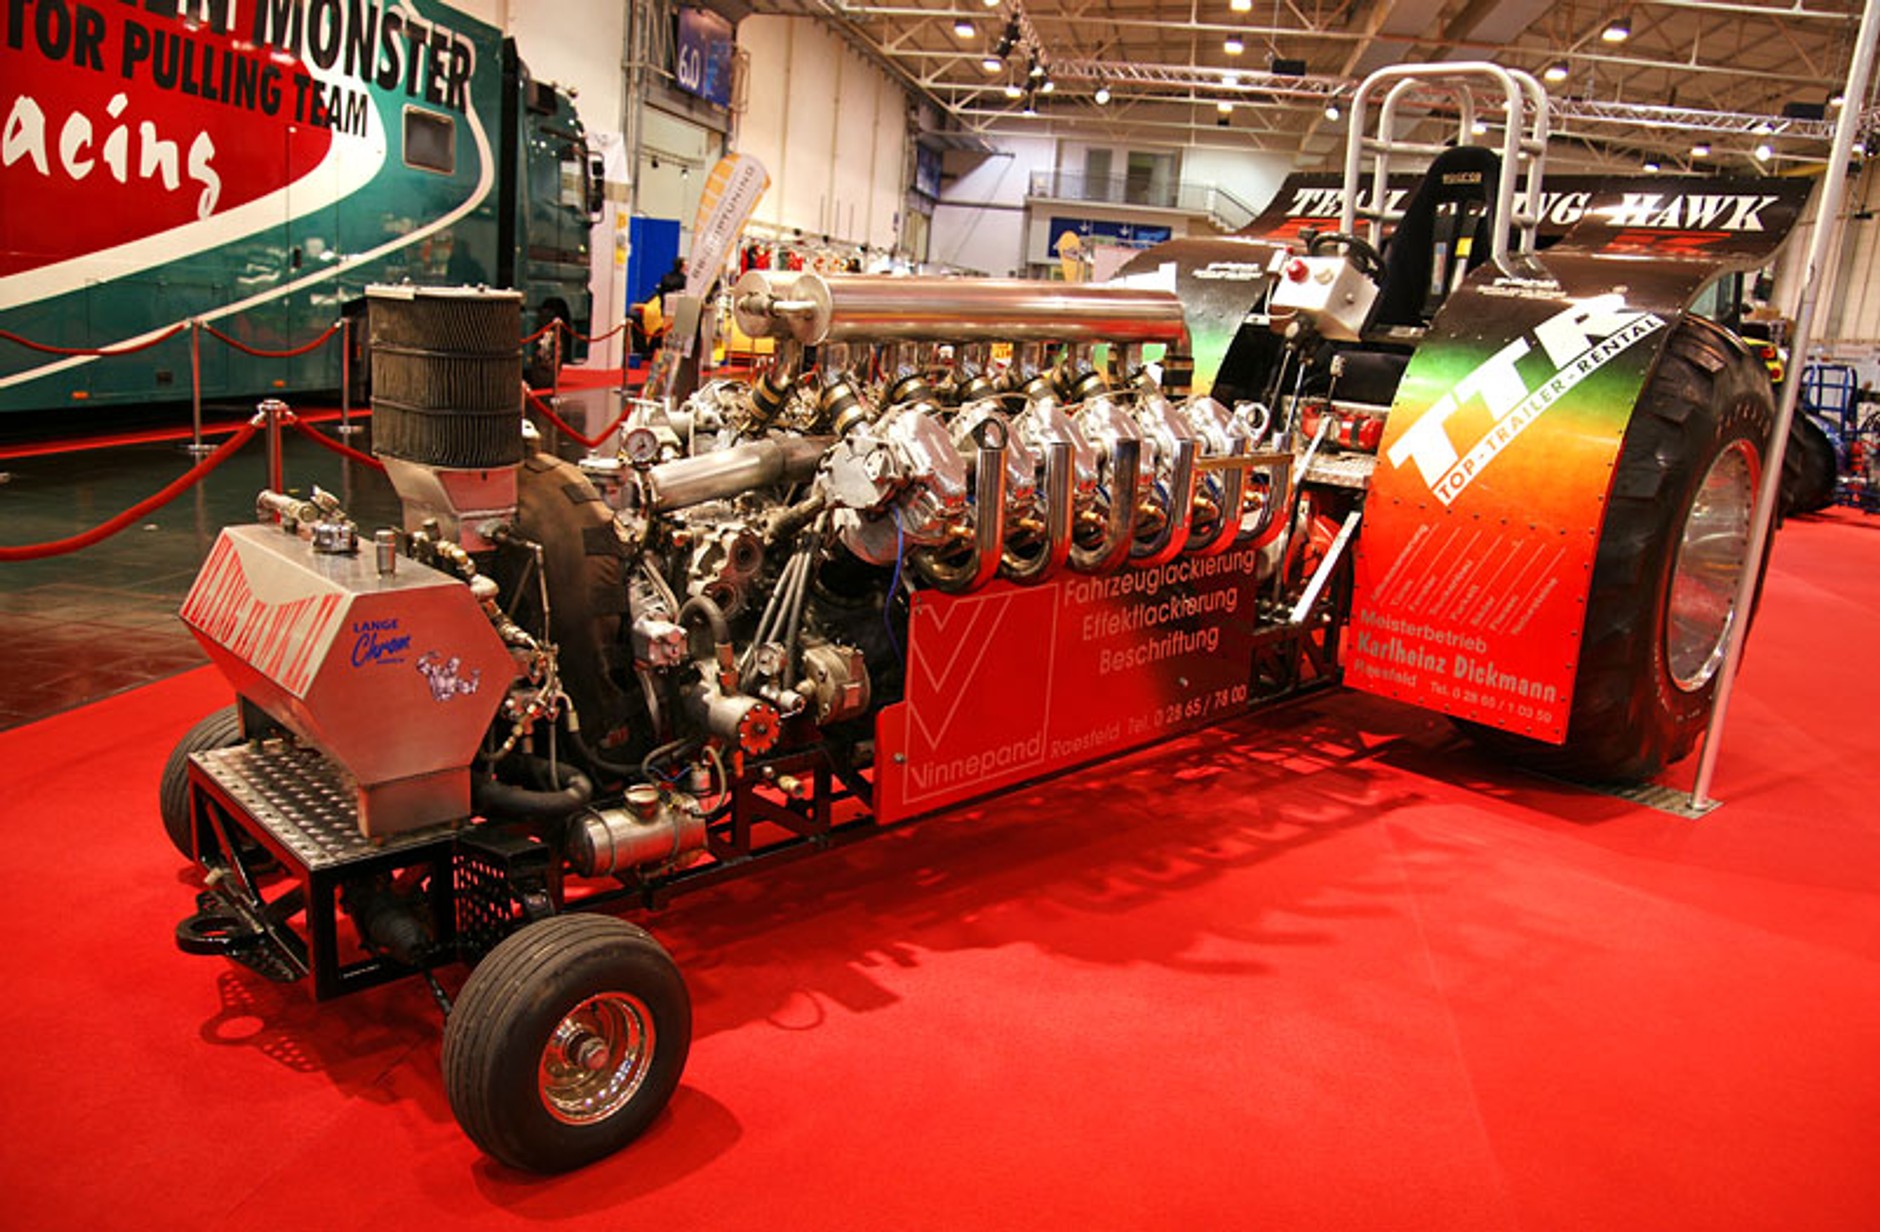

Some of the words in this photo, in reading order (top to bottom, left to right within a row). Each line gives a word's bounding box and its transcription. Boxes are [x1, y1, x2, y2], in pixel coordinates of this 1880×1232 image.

[121, 19, 282, 116] PULLING
[294, 73, 368, 138] TEAM
[252, 0, 473, 115] MONSTER
[2, 92, 222, 219] acing
[1605, 193, 1780, 231] HAWK
[1387, 293, 1655, 488] TTR
[1064, 550, 1257, 607] Fahrzeuglackierung
[353, 618, 398, 633] LANGE
[1083, 587, 1238, 641] Effektlackierung
[1360, 608, 1488, 653] Meisterbetrieb
[1100, 626, 1220, 674] Beschriftung
[1357, 631, 1447, 673] Karlheinz
[1454, 654, 1557, 703] Dickmann
[910, 728, 1042, 789] Vinnepand
